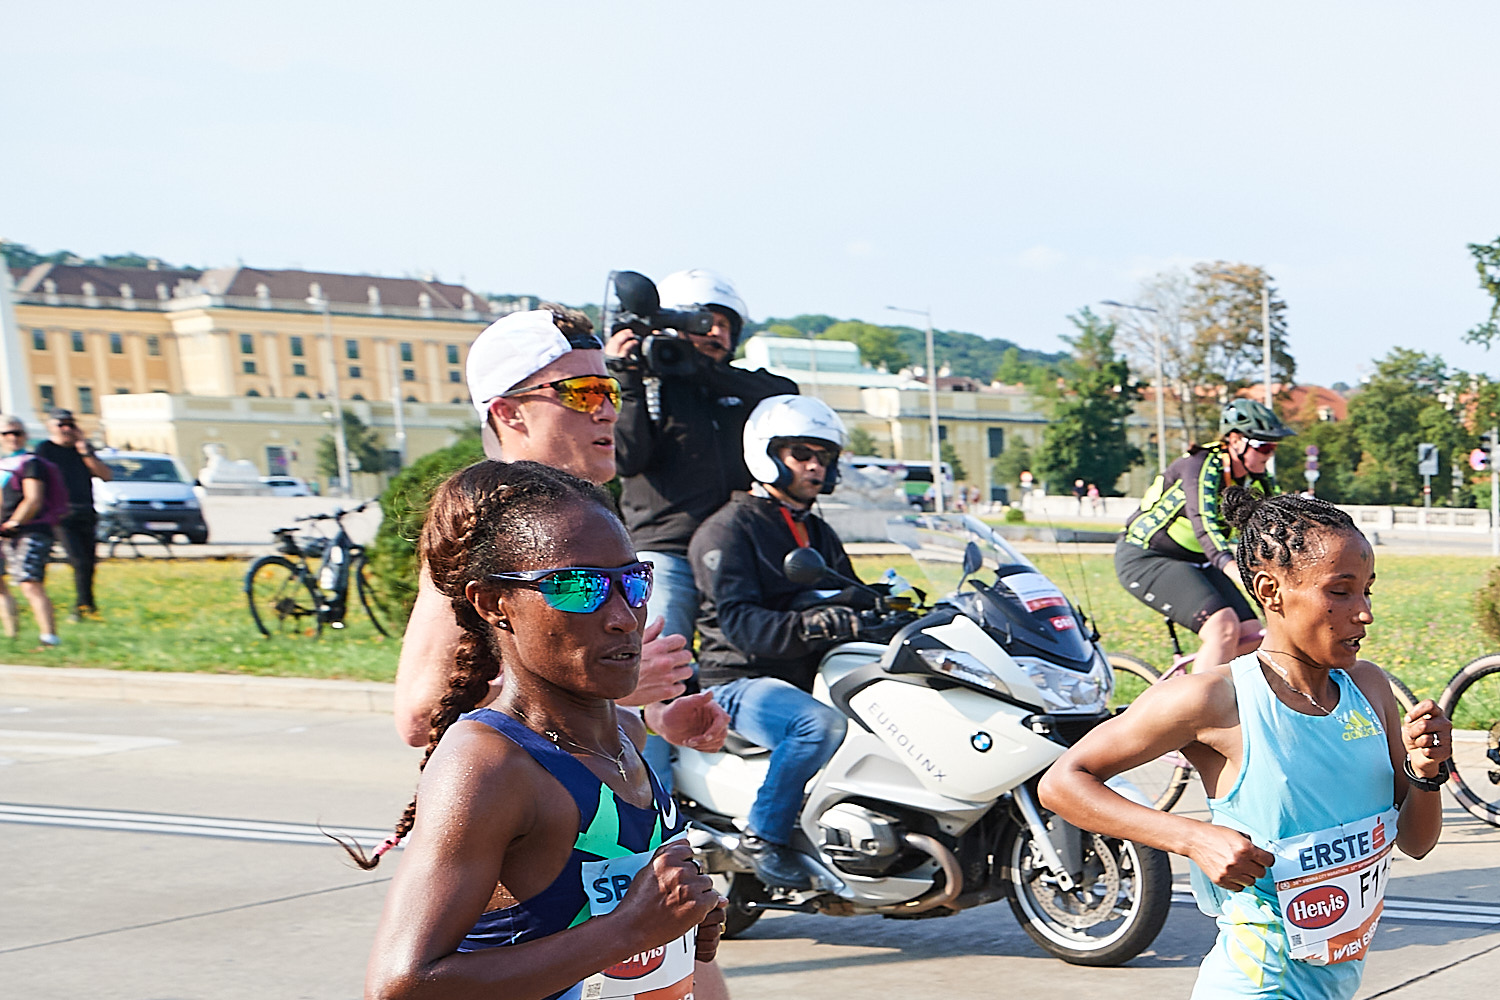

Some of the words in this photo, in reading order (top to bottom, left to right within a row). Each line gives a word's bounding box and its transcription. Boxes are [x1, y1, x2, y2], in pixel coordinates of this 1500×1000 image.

[868, 702, 947, 782] EUROLINX
[1299, 831, 1370, 871] ERSTE
[593, 875, 632, 903] SP
[1292, 894, 1346, 921] Hervis
[1333, 939, 1362, 961] WIEN
